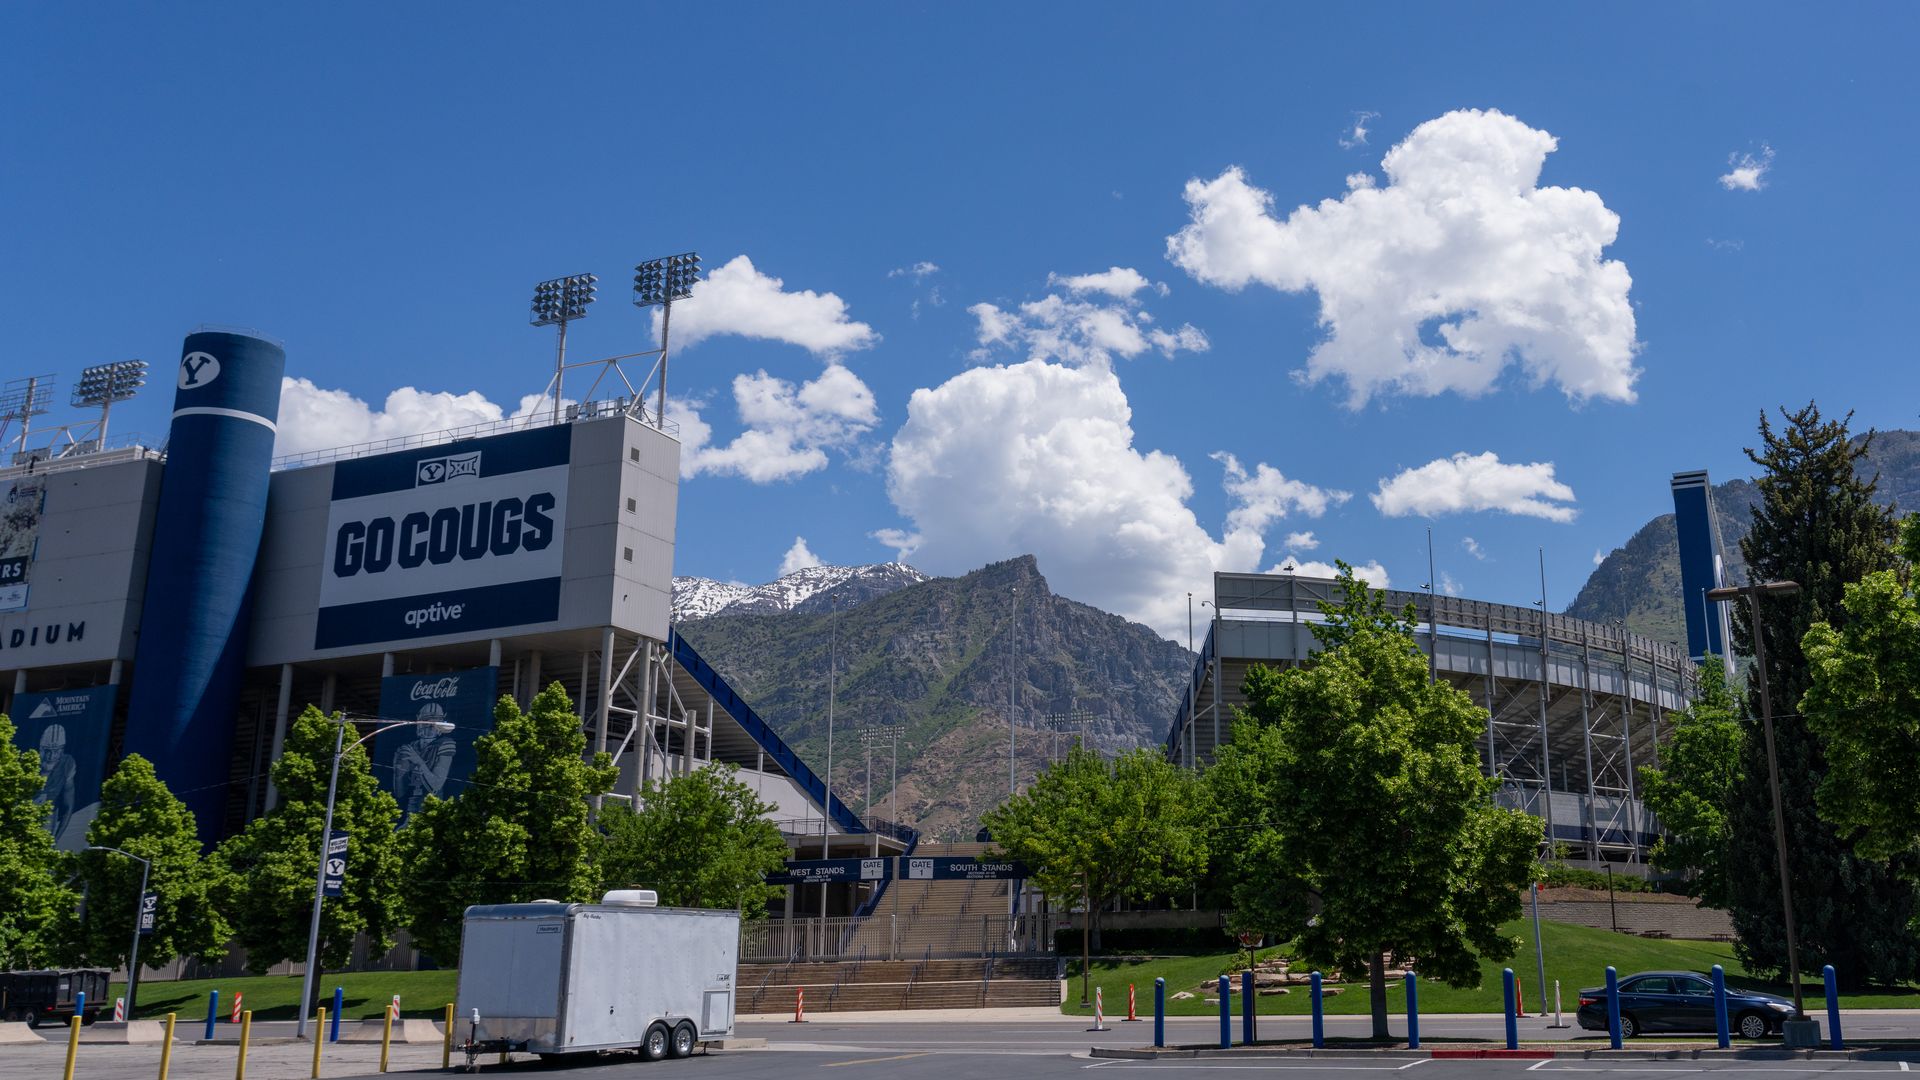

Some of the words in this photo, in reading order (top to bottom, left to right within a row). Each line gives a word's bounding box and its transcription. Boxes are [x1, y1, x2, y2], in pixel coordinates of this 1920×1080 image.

[183, 356, 211, 386] Y
[425, 464, 441, 480] Y
[451, 460, 475, 476] XII
[333, 516, 396, 578] GO
[398, 492, 556, 570] COUGS
[0, 562, 22, 579] RS
[405, 601, 462, 629] aptive
[0, 621, 86, 650] DIUM
[410, 676, 460, 701] Coca-Cola
[329, 860, 343, 874] Y
[790, 868, 811, 876] WEST
[815, 867, 845, 876] STANDS
[863, 861, 882, 869] GATE
[911, 861, 932, 869] GATE
[950, 863, 978, 872] SOUTH
[981, 863, 1013, 872] STANDS
